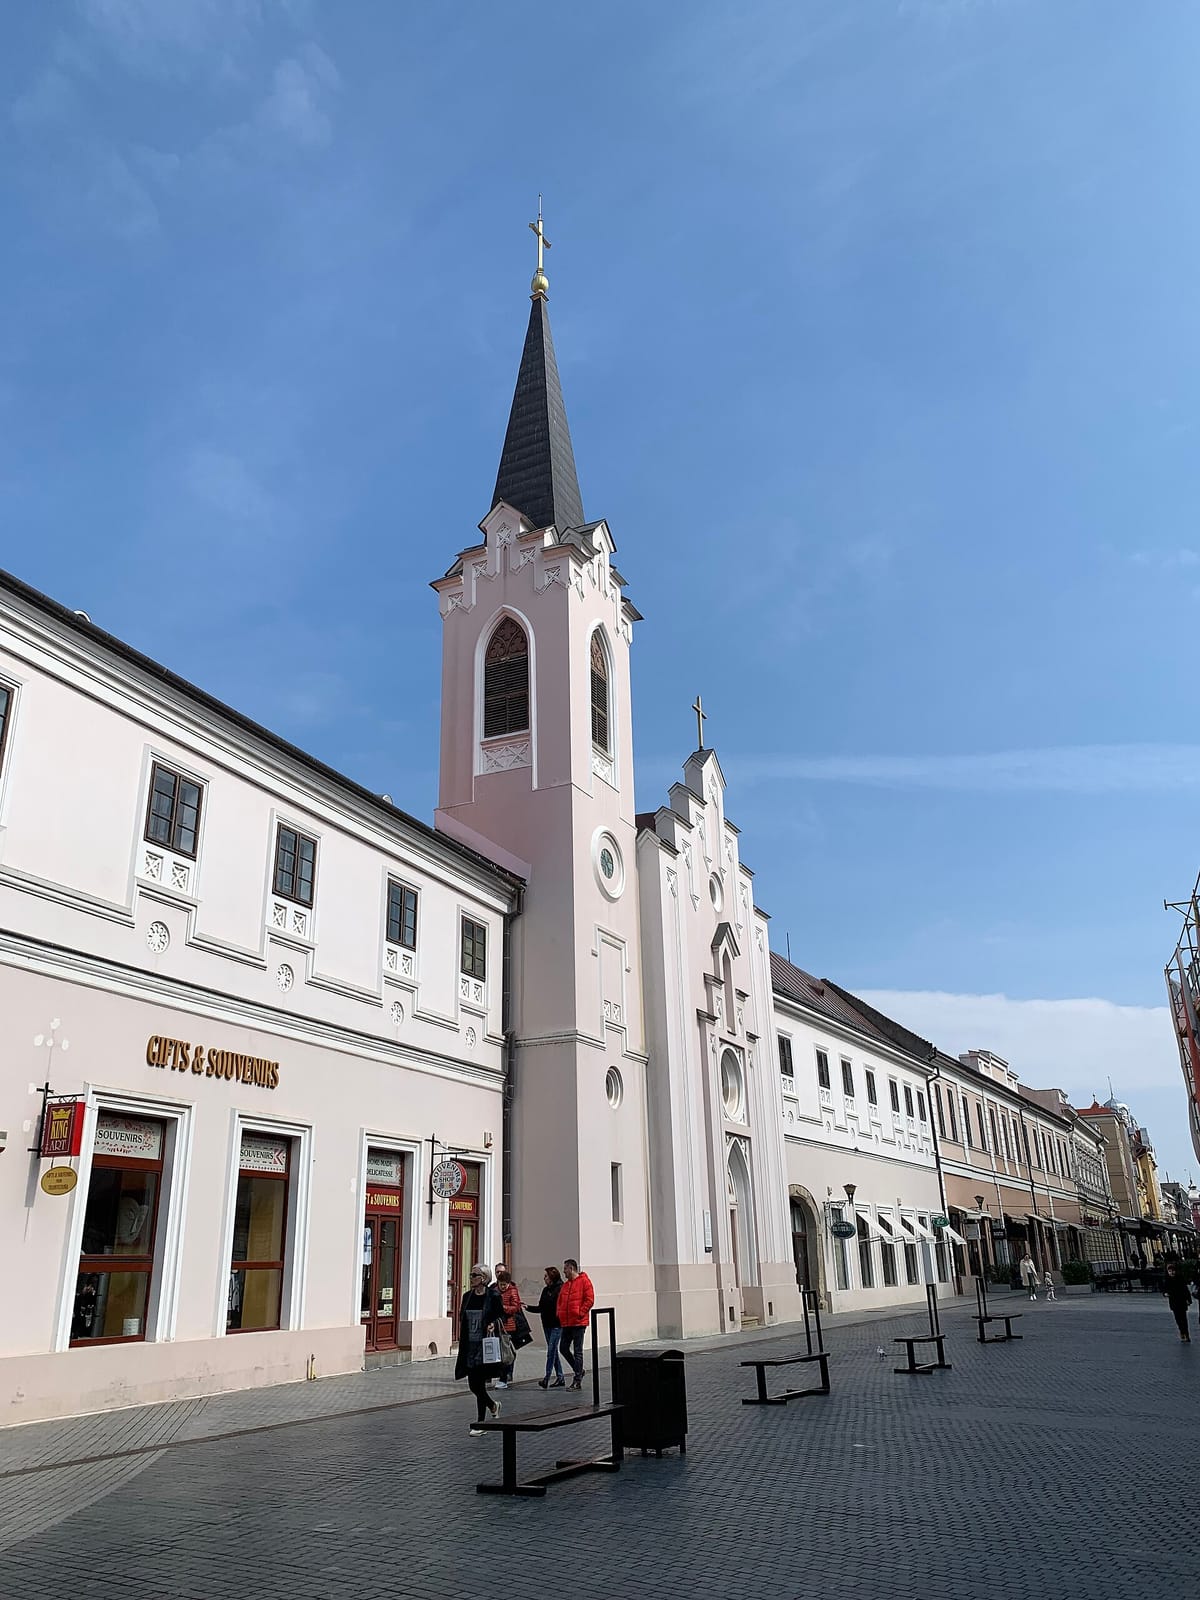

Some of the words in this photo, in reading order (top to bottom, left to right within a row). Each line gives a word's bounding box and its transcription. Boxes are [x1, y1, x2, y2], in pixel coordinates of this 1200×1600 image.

[146, 1035, 190, 1072] GIFTS
[191, 1045, 206, 1076] &
[206, 1047, 280, 1090] SOUVENIRS
[50, 1120, 69, 1140] KING
[97, 1129, 143, 1144] SOUVENIRS
[240, 1149, 274, 1160] SOUVENIRS
[433, 1162, 461, 1184] SOUVENIRS
[436, 1187, 457, 1197] GIFTS
[374, 1193, 400, 1207] SOUVENIRS
